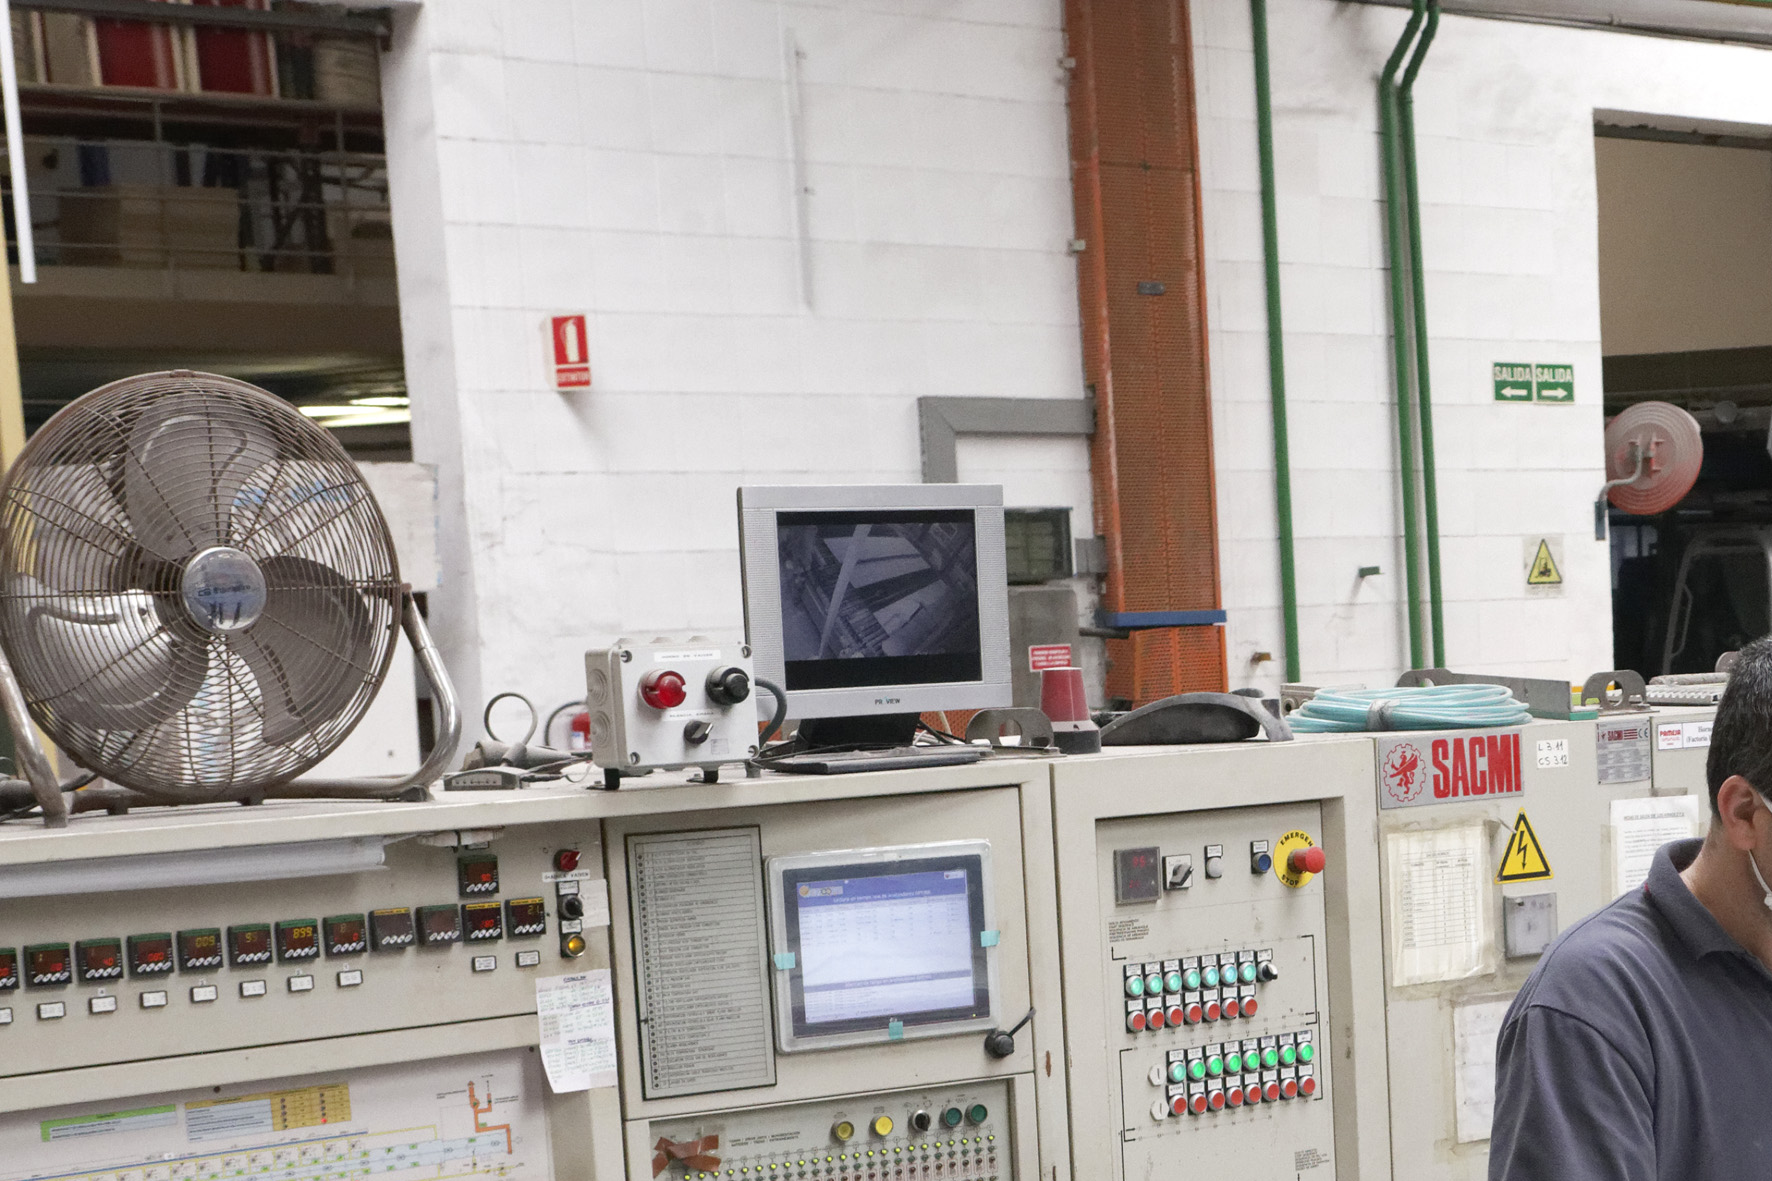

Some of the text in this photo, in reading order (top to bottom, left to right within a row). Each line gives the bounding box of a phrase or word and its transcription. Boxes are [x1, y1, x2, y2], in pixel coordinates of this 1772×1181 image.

[1494, 366, 1533, 381] SALIDA
[1536, 368, 1573, 382] SALIDA
[1431, 734, 1521, 798] SACMI
[1281, 874, 1299, 886] STOP
